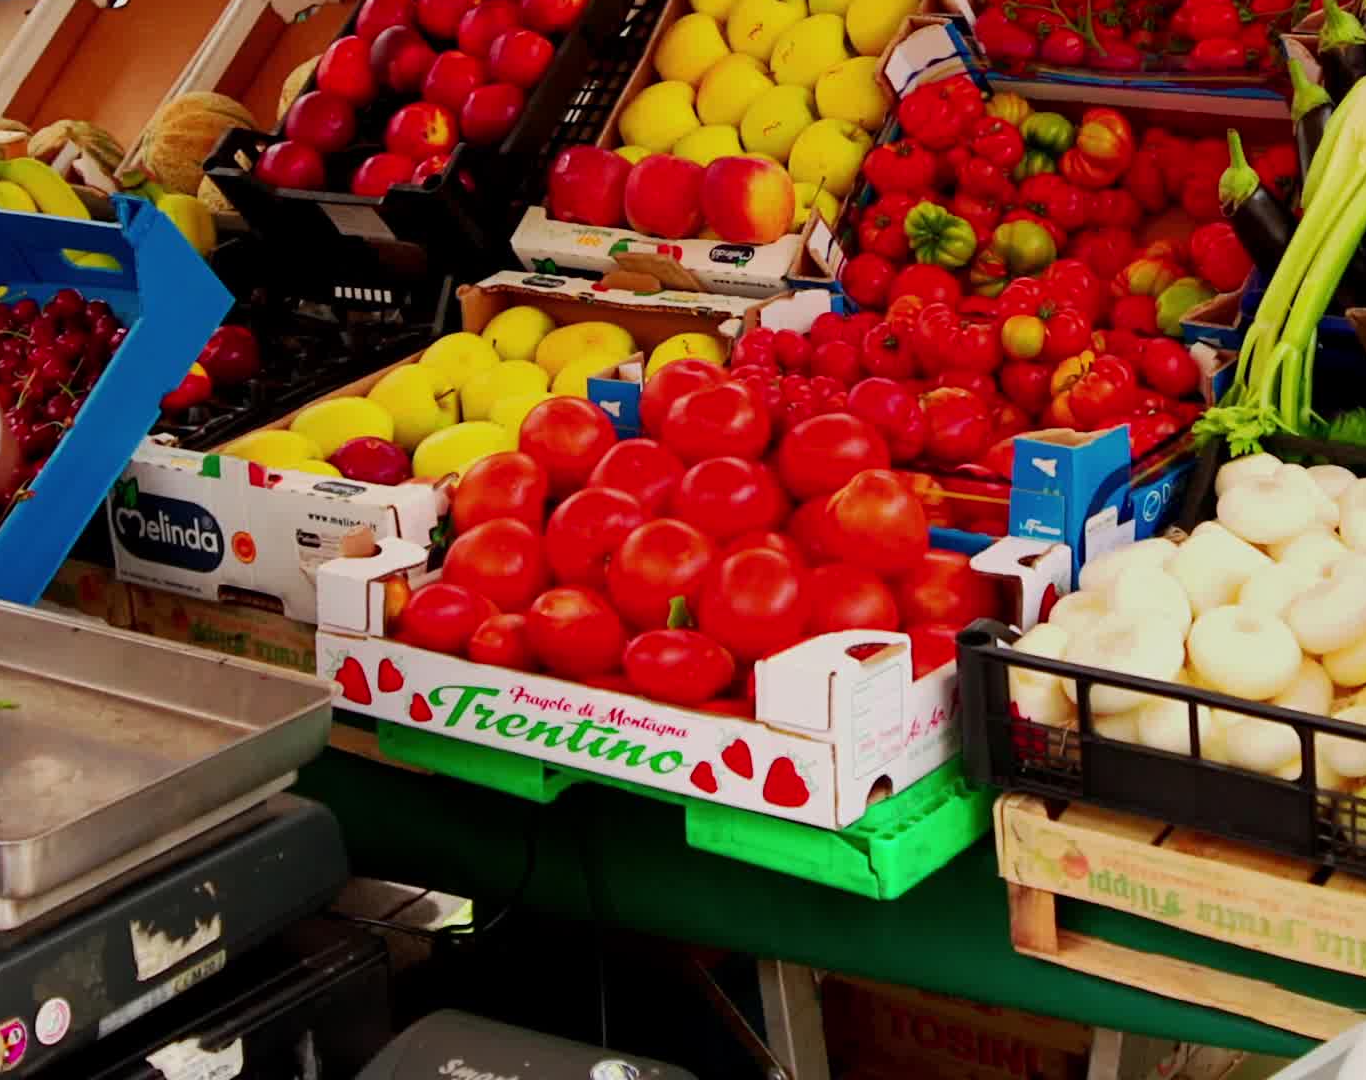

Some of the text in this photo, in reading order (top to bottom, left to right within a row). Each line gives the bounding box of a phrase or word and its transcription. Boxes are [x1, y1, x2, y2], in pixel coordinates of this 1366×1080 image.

[116, 507, 219, 553] Melinda
[428, 685, 686, 774] Trentino
[578, 704, 595, 716] di
